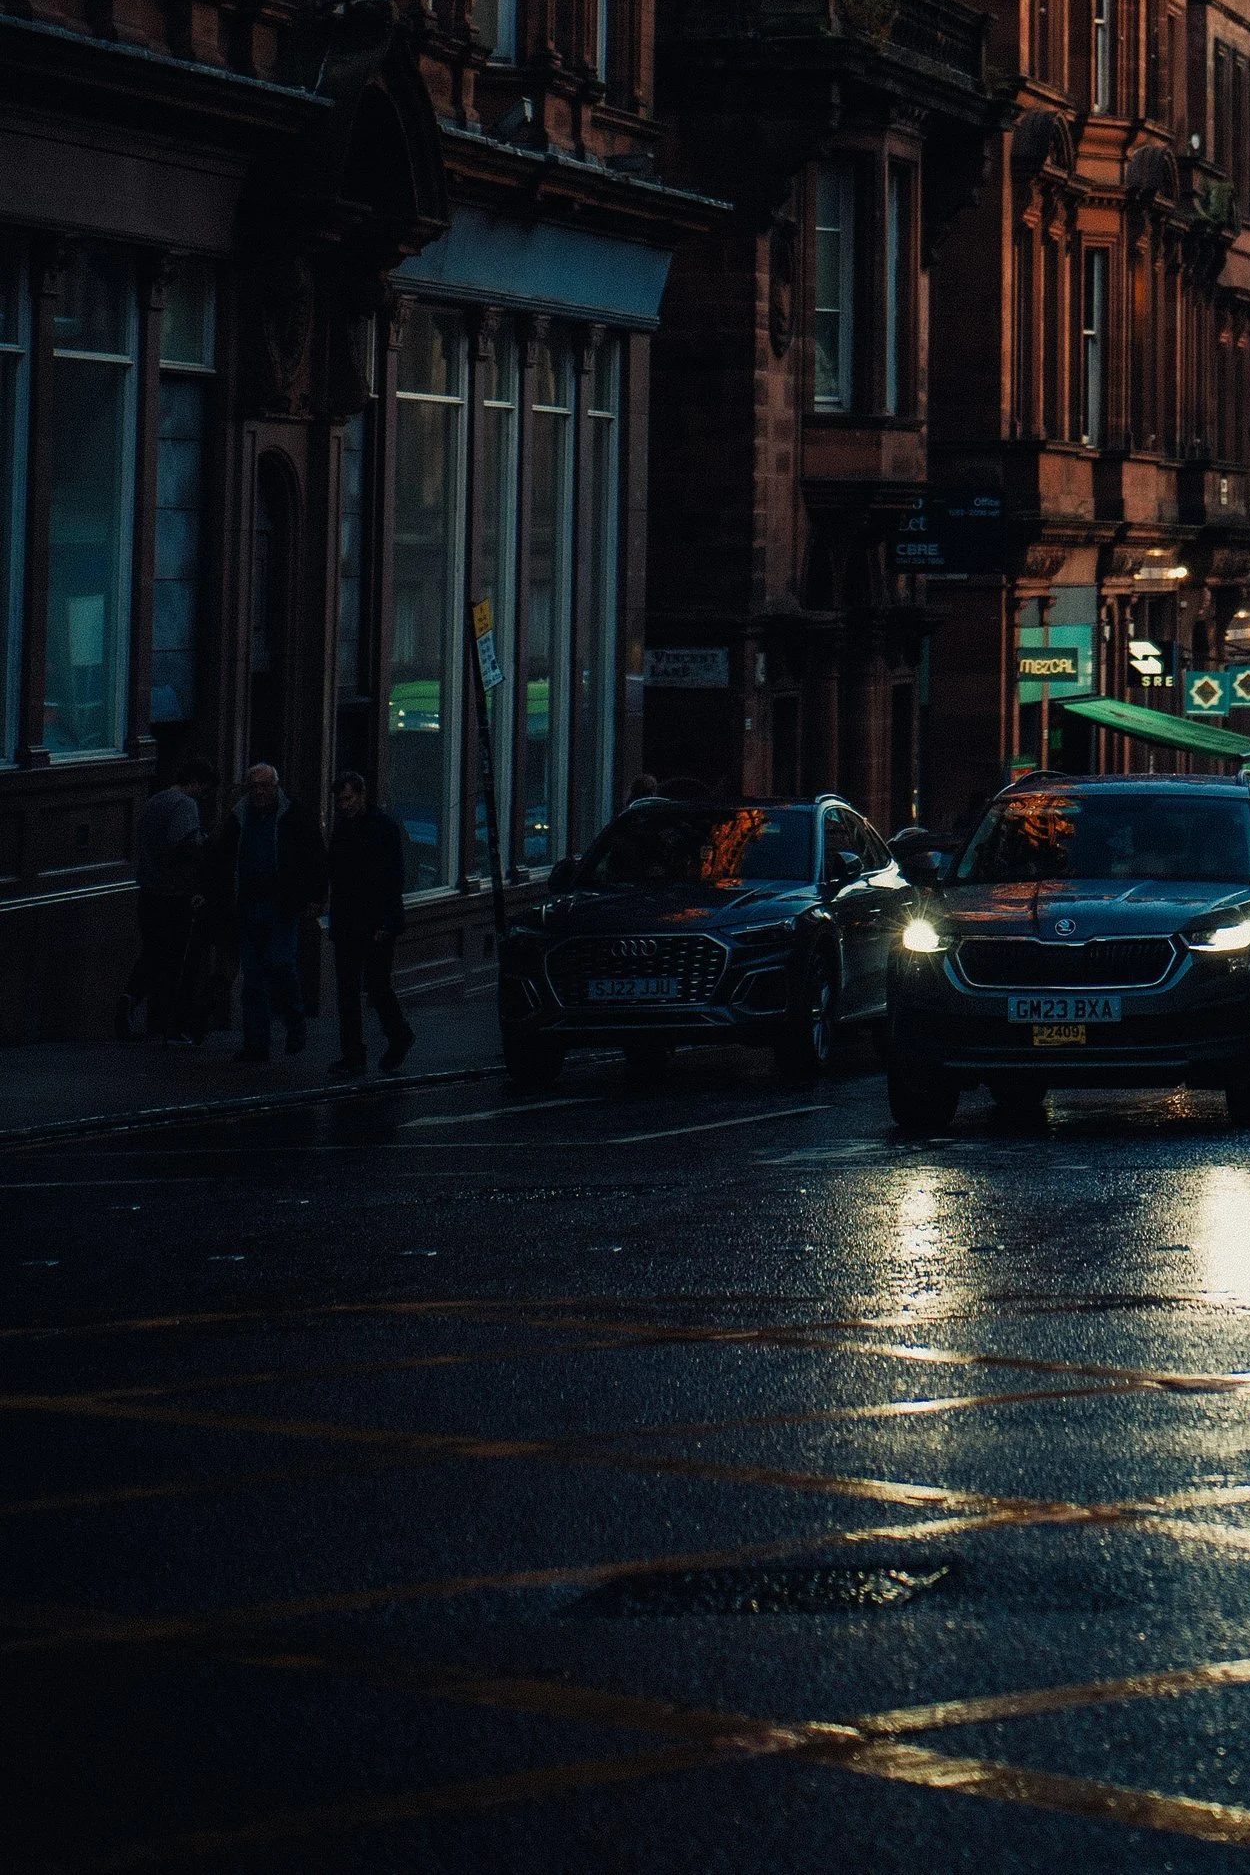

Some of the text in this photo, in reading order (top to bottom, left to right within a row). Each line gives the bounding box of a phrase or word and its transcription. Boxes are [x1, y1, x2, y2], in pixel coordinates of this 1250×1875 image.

[896, 543, 941, 556] CBRE
[1019, 658, 1077, 675] MEZCAL
[1140, 675, 1174, 688] SRE
[1016, 999, 1113, 1019] GM23 BXA
[1046, 1026, 1080, 1039] 2409
